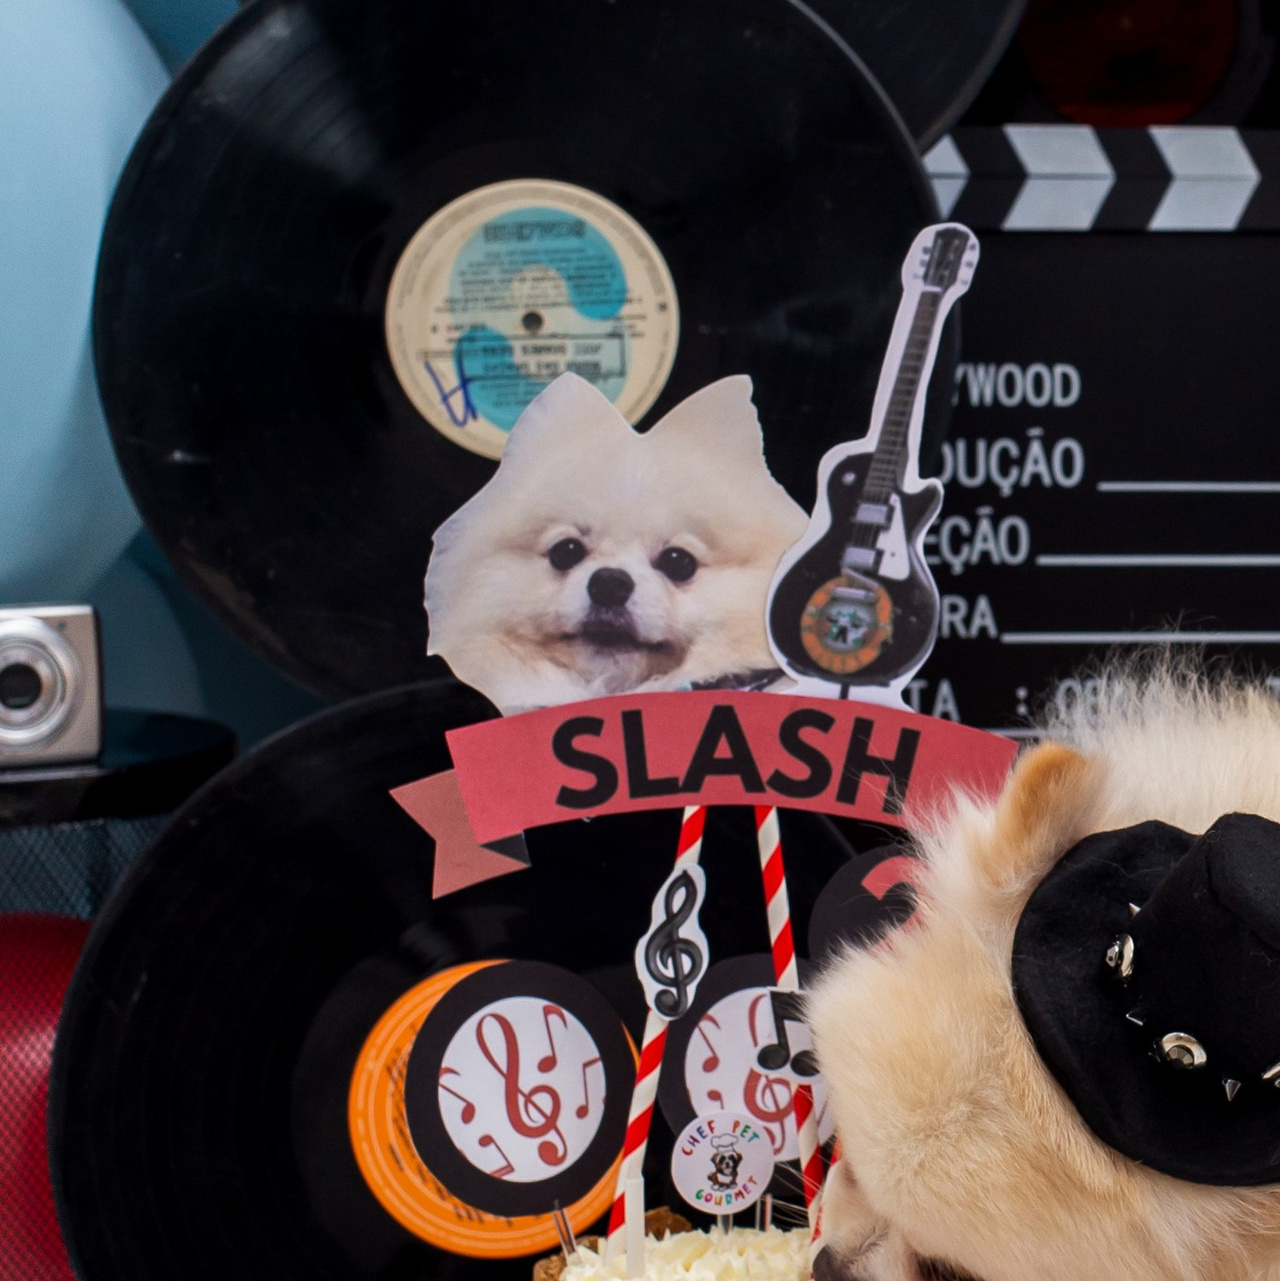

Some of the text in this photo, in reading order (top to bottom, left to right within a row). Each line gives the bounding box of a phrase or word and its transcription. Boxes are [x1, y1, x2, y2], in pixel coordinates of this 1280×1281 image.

[551, 704, 921, 815] SLASH
[682, 1120, 760, 1156] CHEF PET
[695, 1175, 758, 1206] GOURMET
